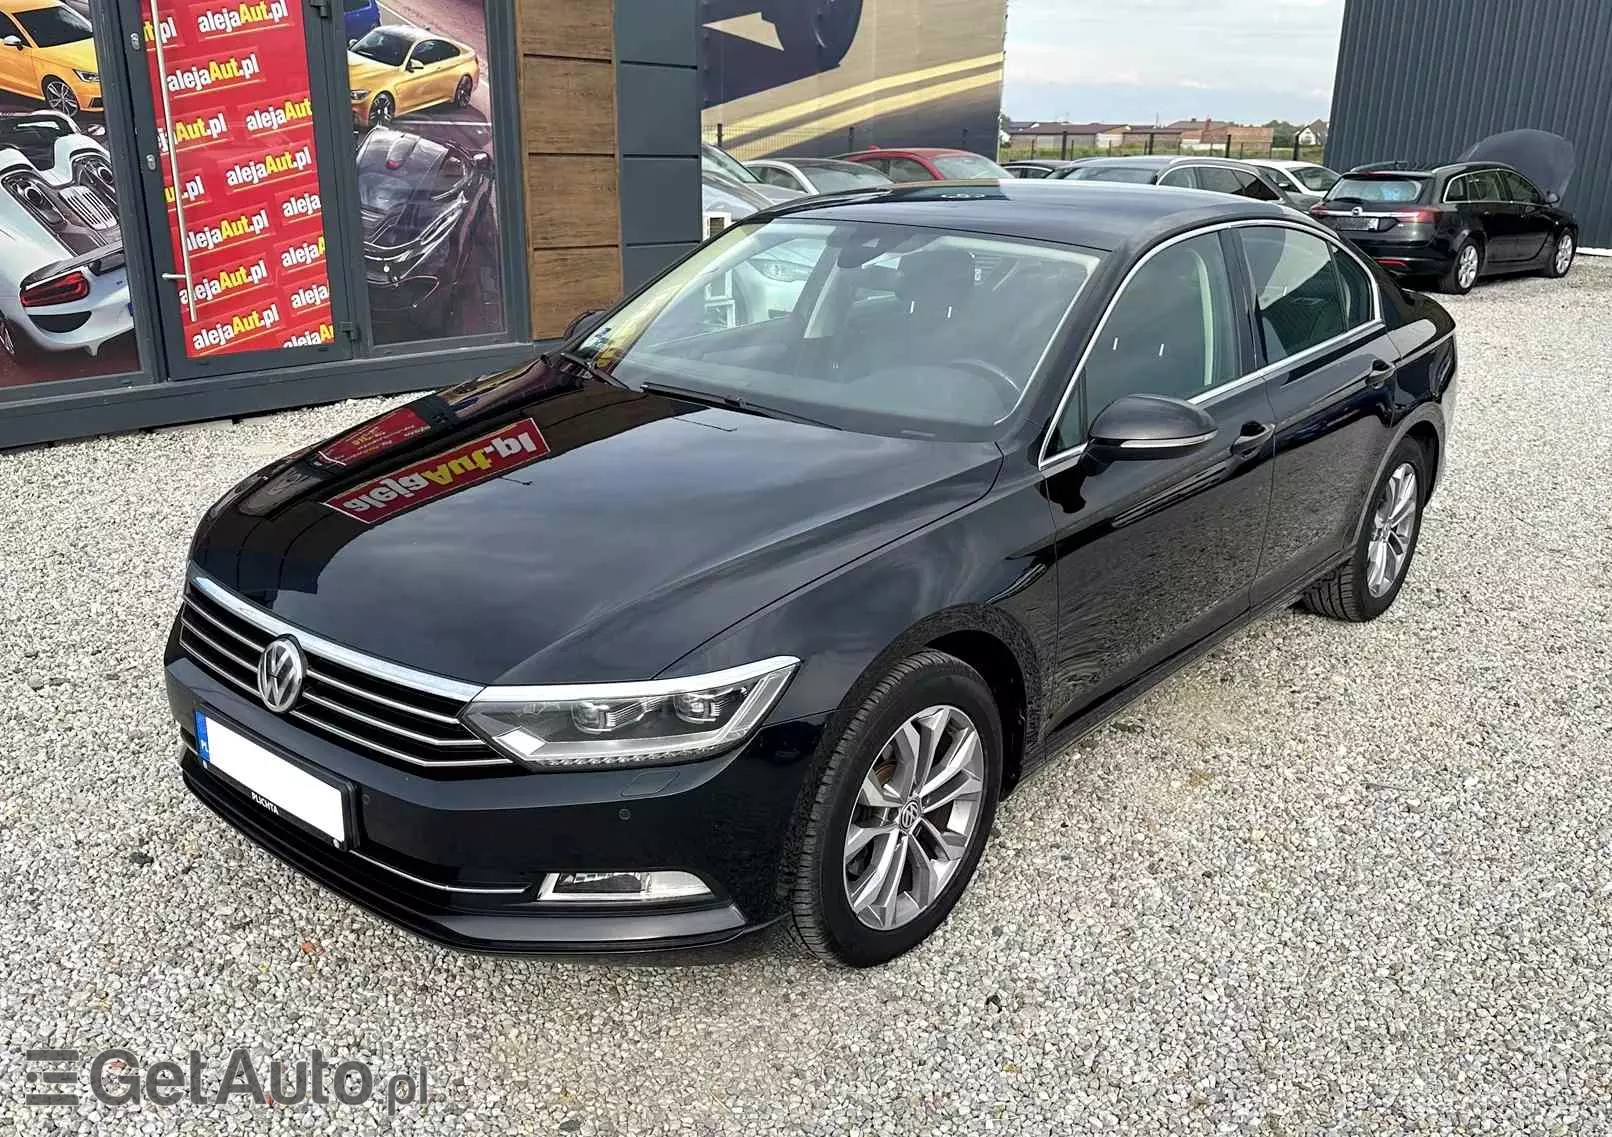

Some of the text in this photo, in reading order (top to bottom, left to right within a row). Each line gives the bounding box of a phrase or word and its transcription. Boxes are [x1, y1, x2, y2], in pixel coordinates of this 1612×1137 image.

[197, 0, 289, 33] alejaAut.pl
[167, 53, 261, 92] alejaAut.pl
[245, 98, 313, 131] alejaAut
[226, 146, 312, 187] alejaAut.pl
[282, 193, 322, 218] aleja
[179, 259, 268, 305] aejaAut.pl
[192, 303, 280, 350] alejaAut.pl
